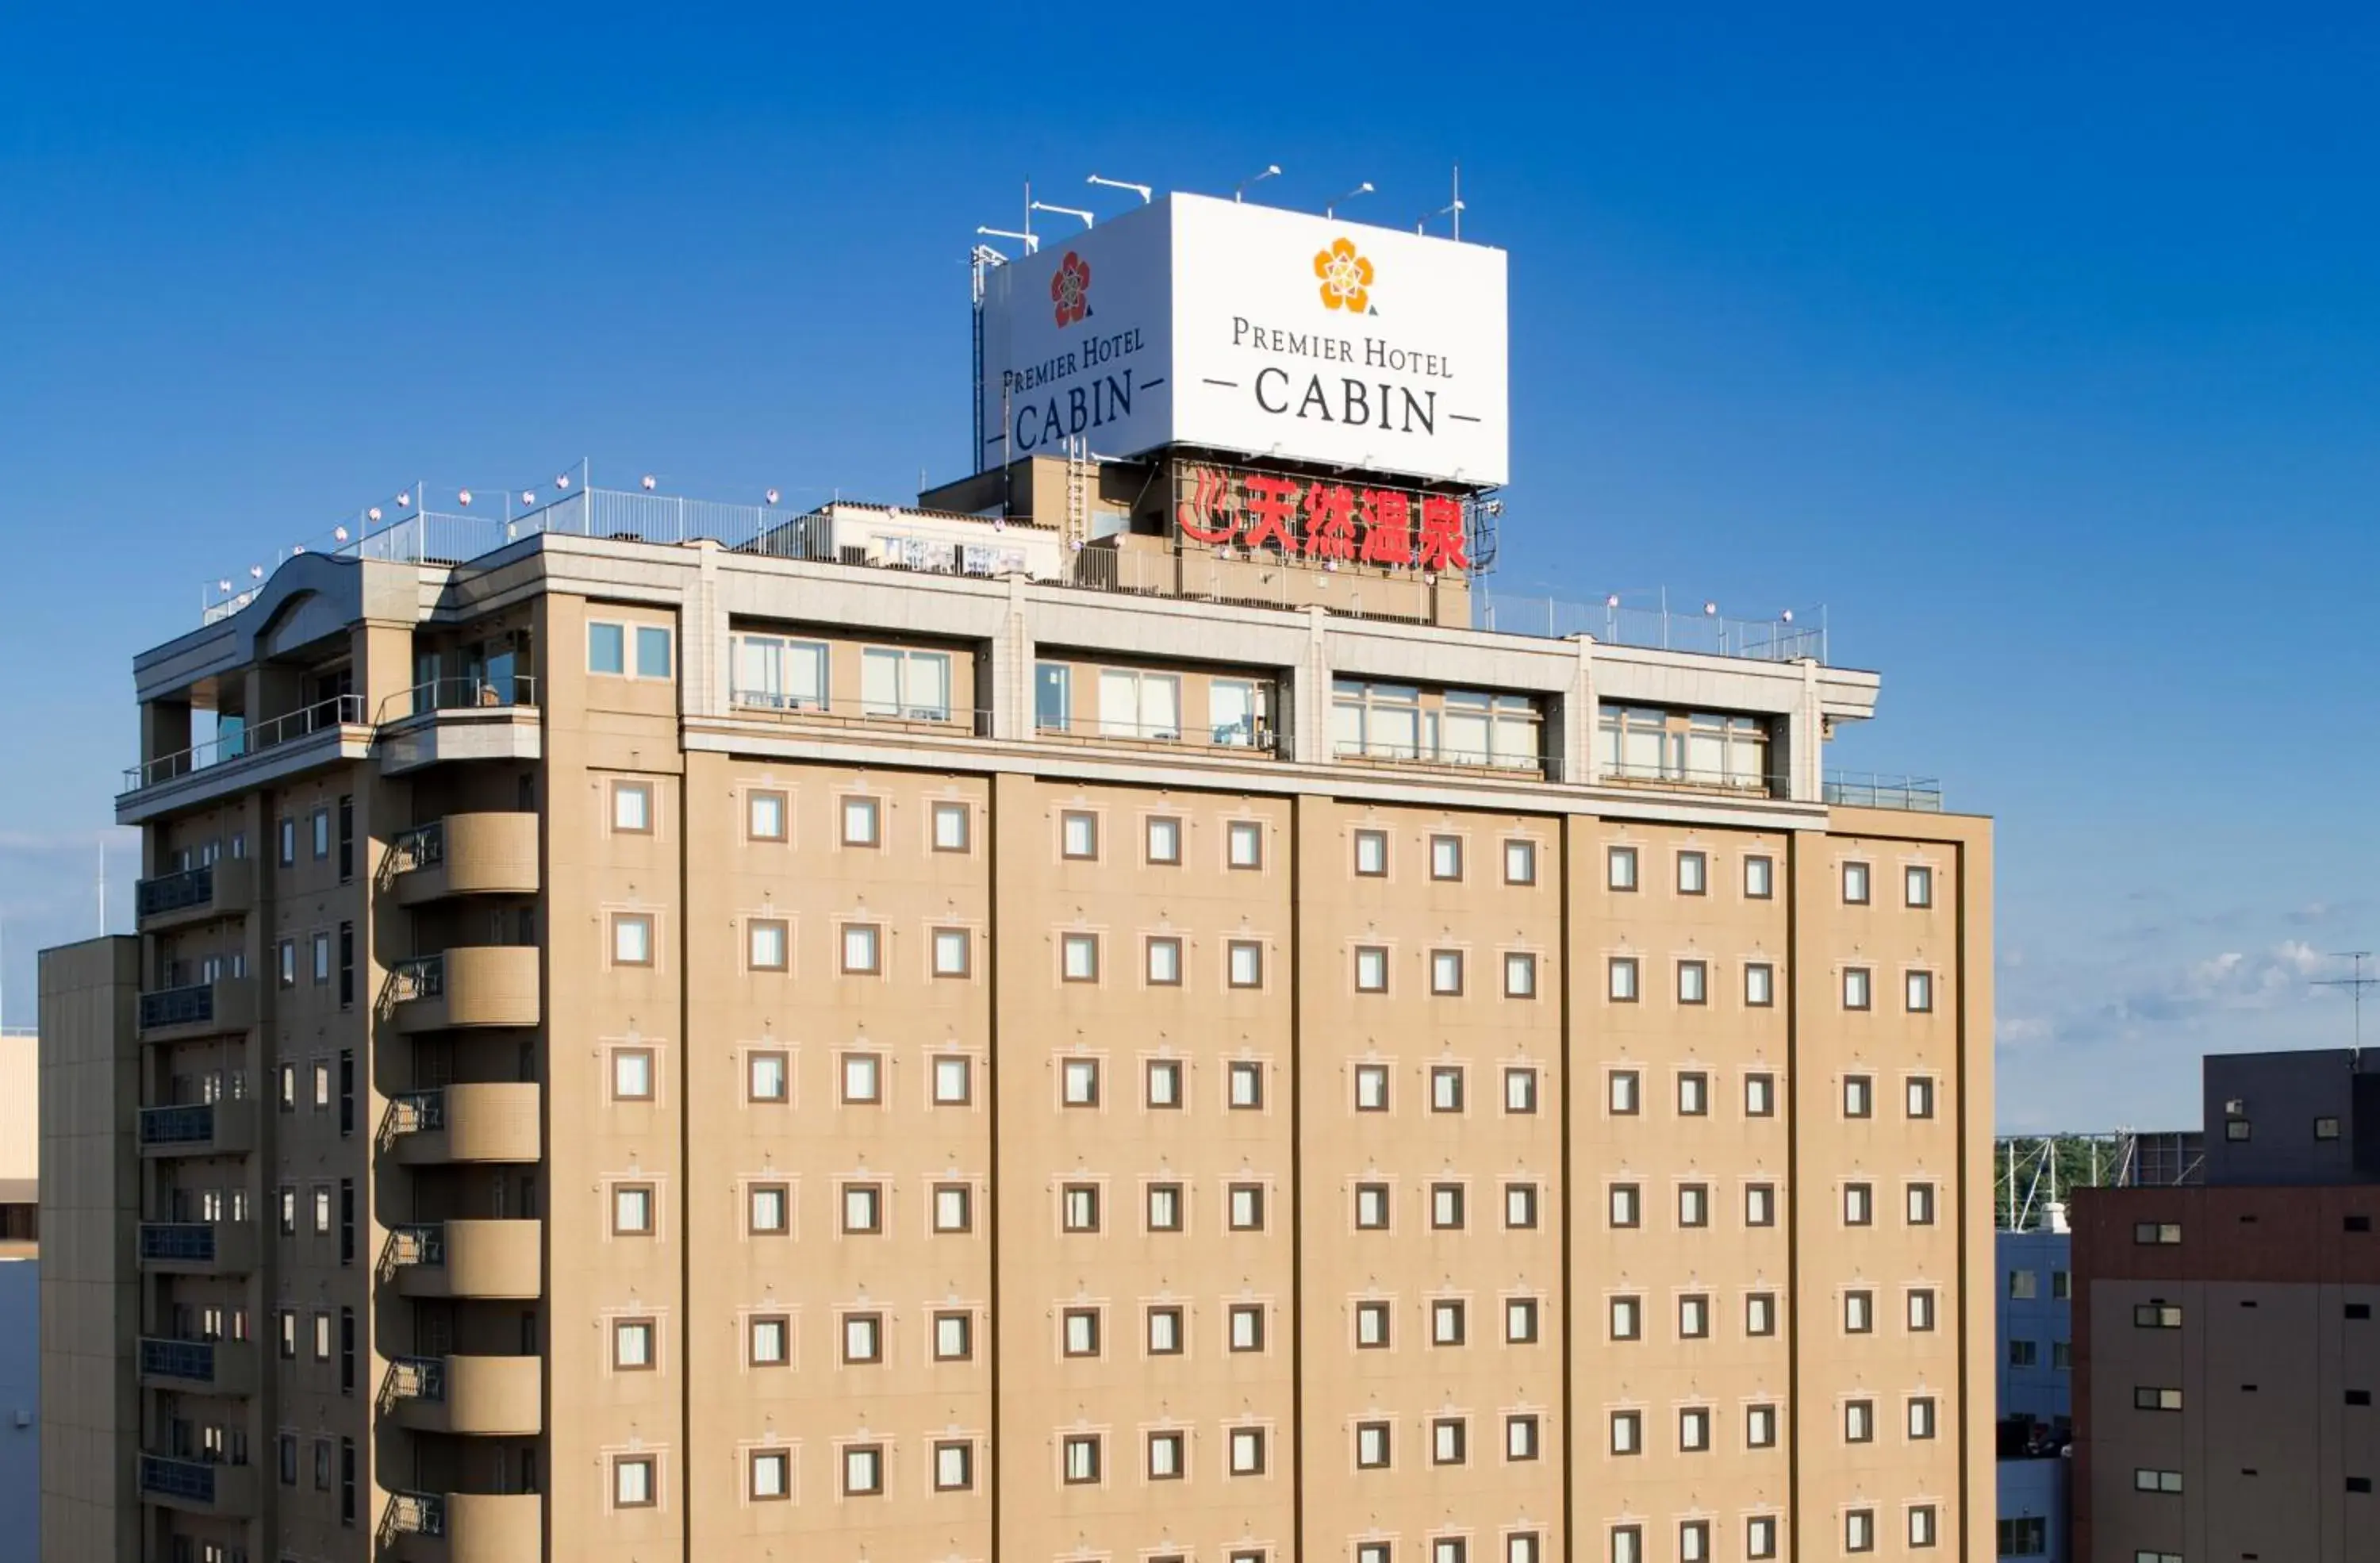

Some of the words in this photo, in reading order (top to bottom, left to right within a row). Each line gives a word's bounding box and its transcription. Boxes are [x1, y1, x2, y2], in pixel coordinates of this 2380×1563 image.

[1003, 353, 1077, 398] PREMIER
[1082, 328, 1144, 369] HOTEL
[1232, 316, 1355, 363] PREMIER
[1364, 337, 1453, 378] HOTEL
[1015, 368, 1132, 451] CABIN
[1254, 367, 1437, 436] CABIN
[1243, 475, 1469, 570] 天然温泉
